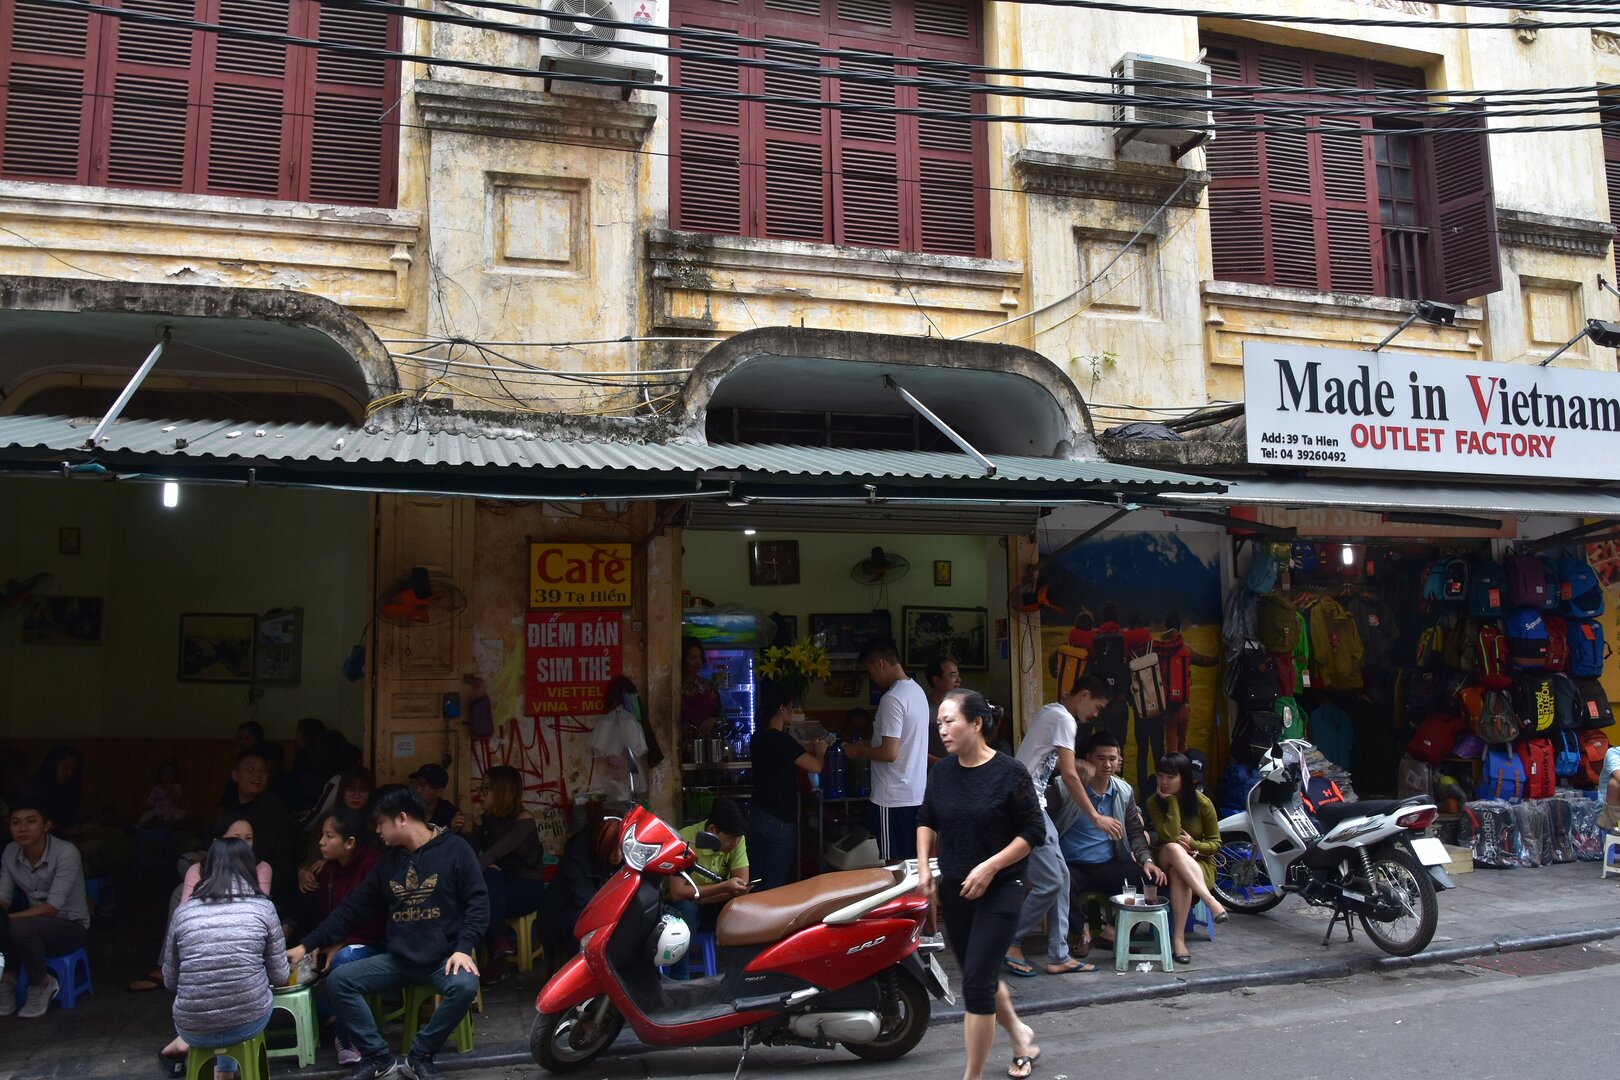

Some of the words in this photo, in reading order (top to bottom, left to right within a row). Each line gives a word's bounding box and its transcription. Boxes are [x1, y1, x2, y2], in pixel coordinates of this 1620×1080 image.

[1274, 358, 1395, 418] Made
[1408, 371, 1449, 421] in
[1465, 374, 1620, 432] Vietnam
[1302, 434, 1313, 445] Ta
[1316, 435, 1339, 447] Hien
[1350, 423, 1445, 452] OUTLET
[1455, 430, 1556, 459] FACTORY
[1261, 447, 1278, 459] Tel:
[1280, 448, 1293, 459] 04
[1297, 449, 1346, 462] 39260492
[537, 548, 626, 585] Café
[535, 588, 561, 603] 39
[565, 591, 585, 606] Tạ
[527, 612, 576, 648] ĐIỂM
[581, 616, 619, 647] BÁN
[536, 656, 573, 683] SIM
[578, 648, 612, 682] THẺ
[547, 686, 604, 698] VIETTEL
[1535, 691, 1545, 715] FACE
[1541, 682, 1550, 715] NORTH
[532, 701, 569, 713] VINA
[392, 906, 441, 922] adidas
